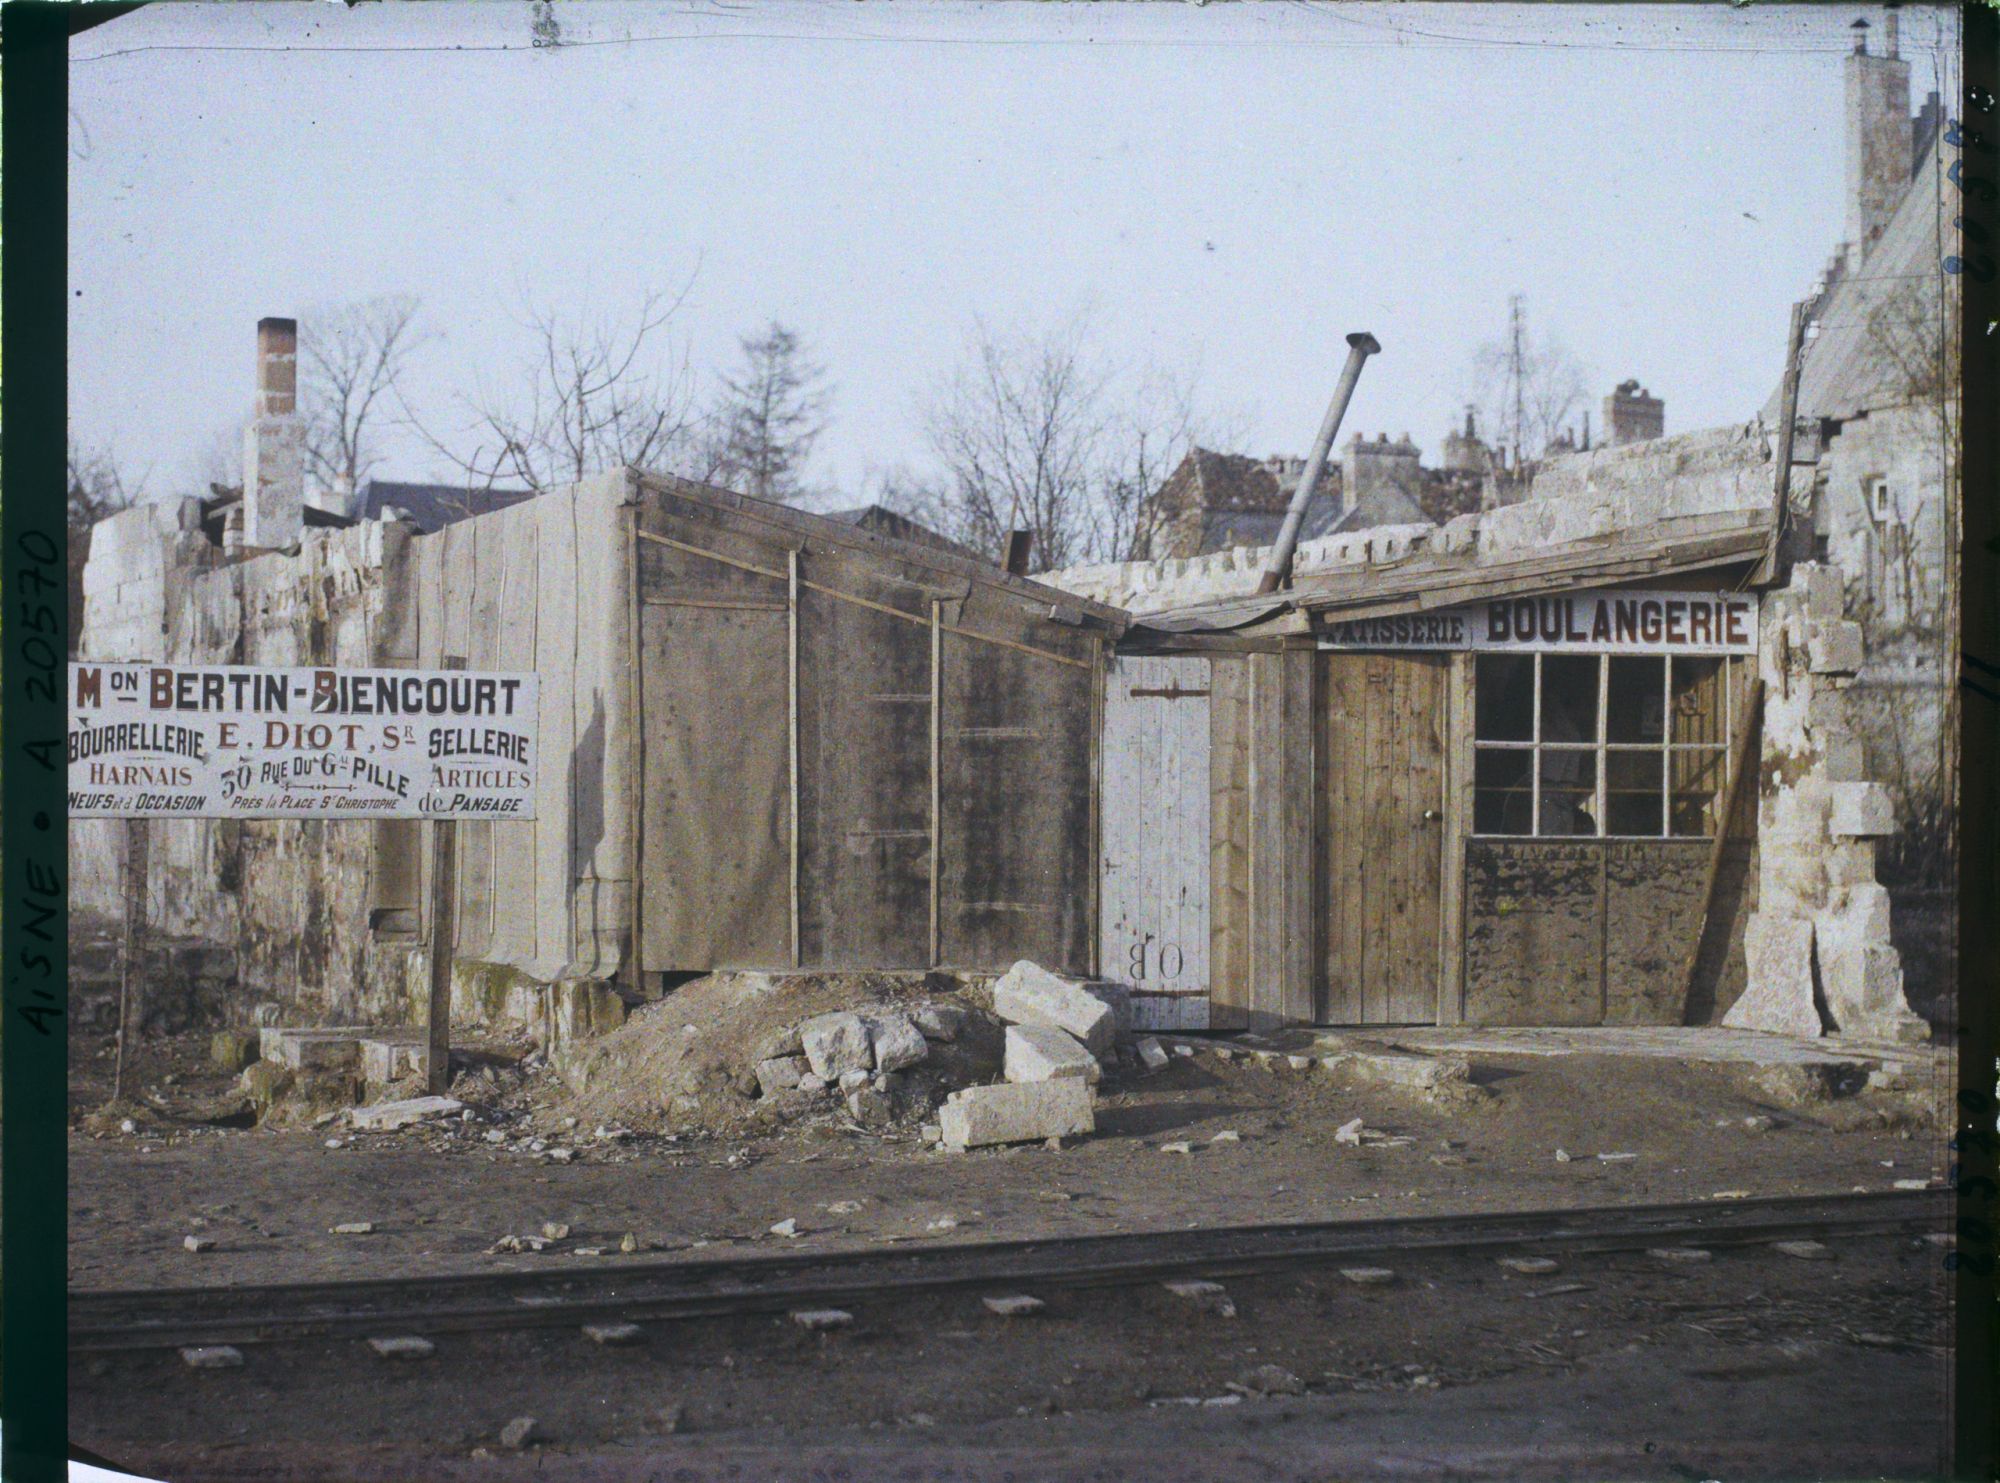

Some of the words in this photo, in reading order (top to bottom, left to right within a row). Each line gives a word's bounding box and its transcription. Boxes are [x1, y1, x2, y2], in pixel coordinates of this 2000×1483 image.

[1487, 600, 1750, 644] BOULANGERIE
[150, 668, 520, 714] BERTIN-BIENCOURT
[68, 723, 204, 764] BOURRELLERIE
[428, 728, 529, 765] SELLERIE
[90, 763, 193, 786] HARNAIS
[260, 761, 288, 784] RUE
[293, 756, 313, 776] DU
[352, 757, 410, 798] PILLE
[431, 765, 531, 789] ARTICLES
[68, 792, 114, 809] NEUFS
[278, 795, 316, 809] PLACE
[335, 796, 400, 810] CHRISTOPHE
[418, 792, 444, 813] de
[449, 793, 523, 812] PANSAGE
